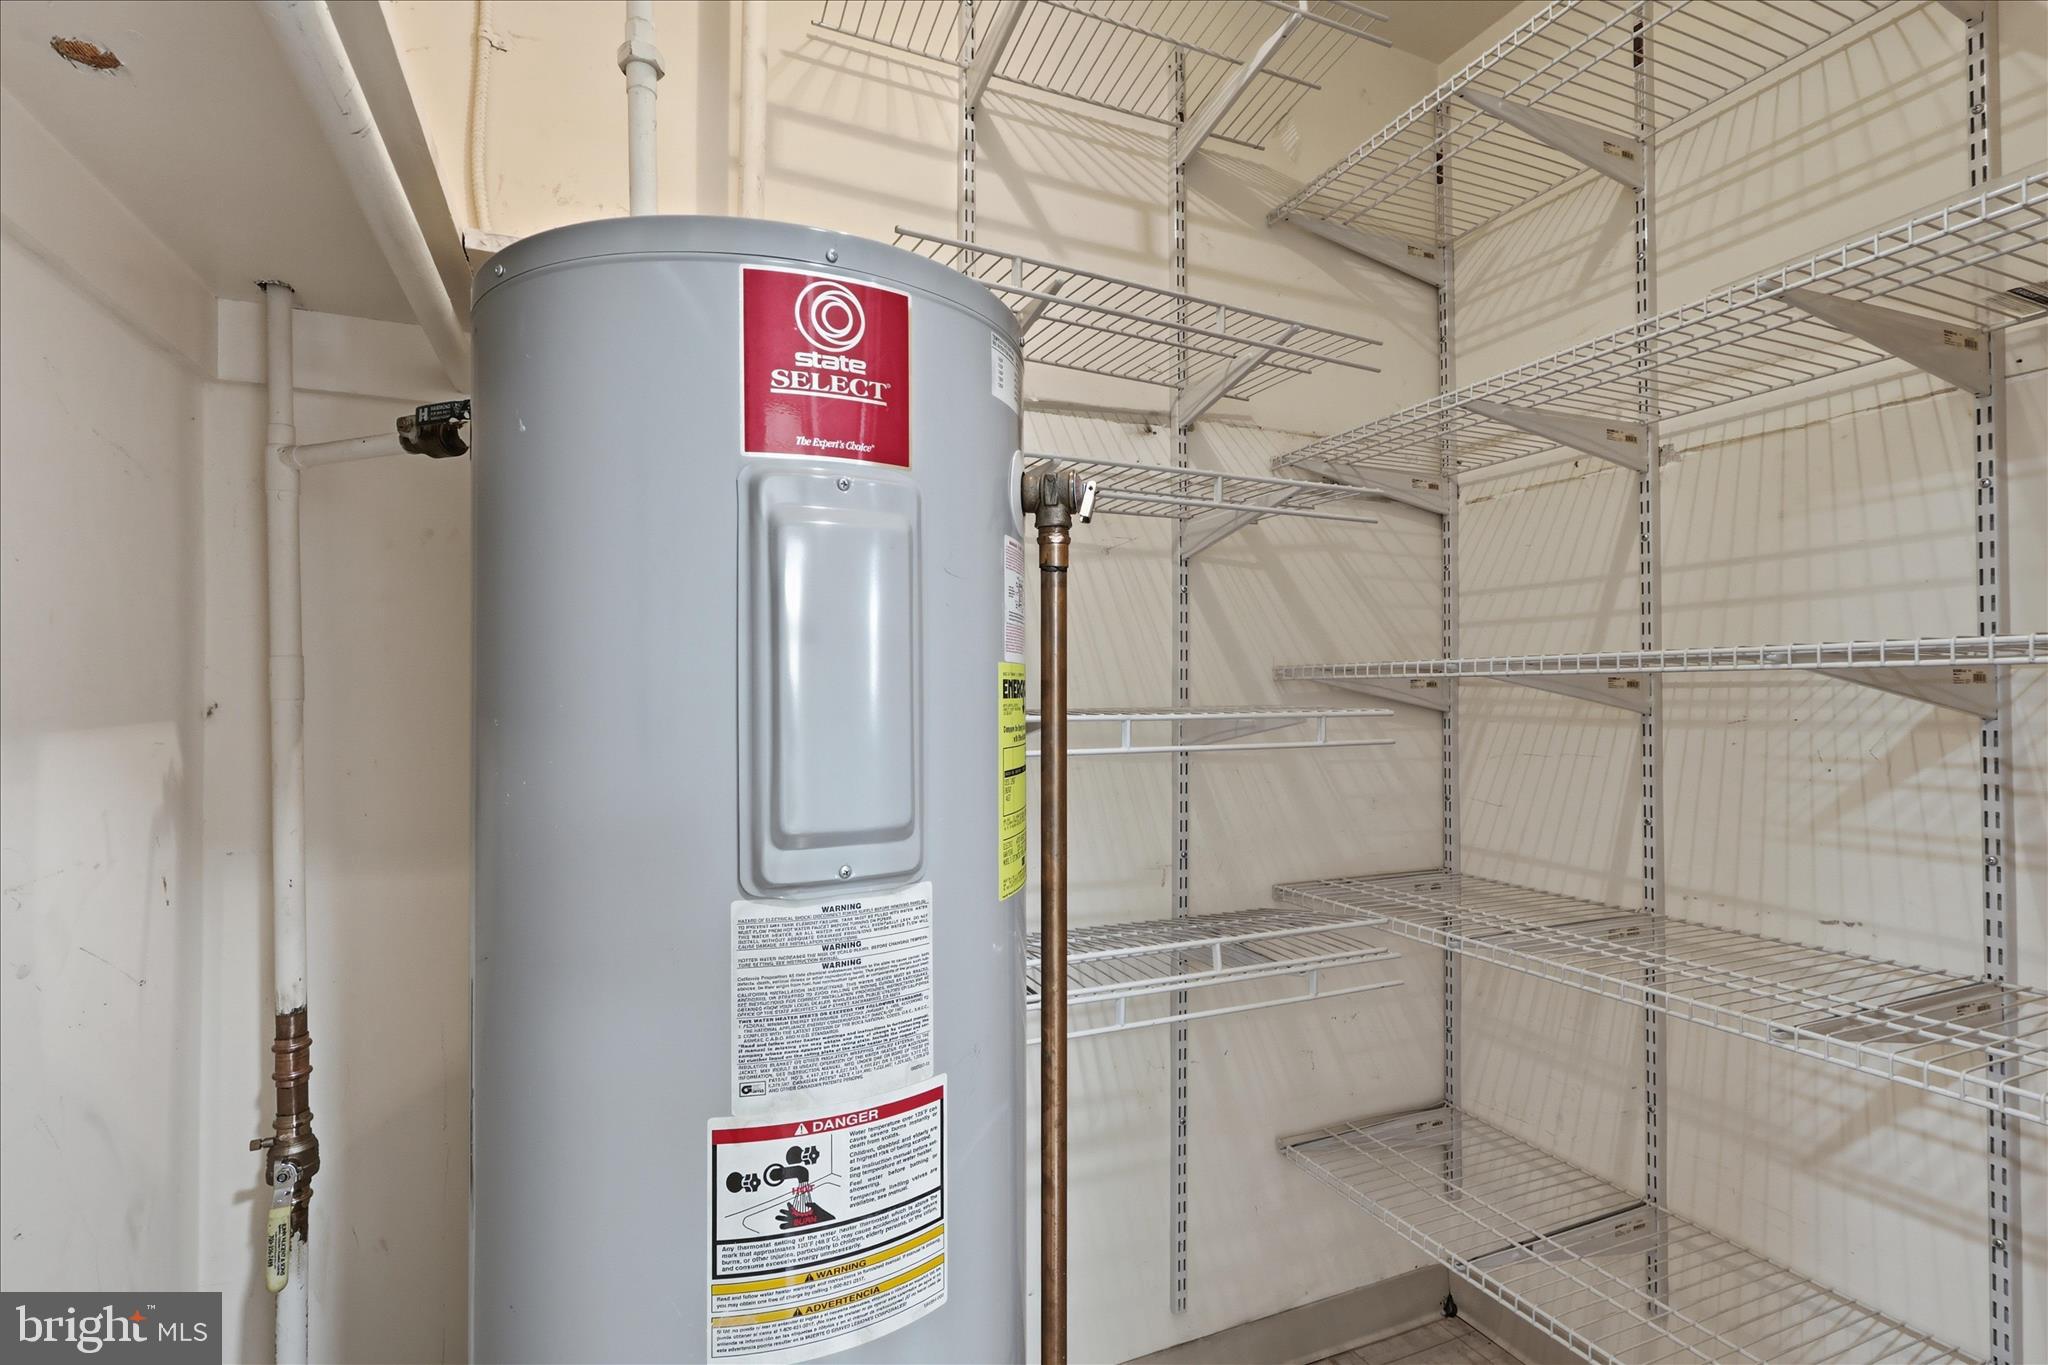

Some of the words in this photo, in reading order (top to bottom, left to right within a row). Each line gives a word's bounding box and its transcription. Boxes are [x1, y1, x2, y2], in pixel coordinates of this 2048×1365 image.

[795, 351, 867, 375] state
[796, 436, 812, 446] The
[822, 903, 862, 913] WARNING
[822, 941, 862, 951] WARNING
[822, 959, 862, 969] WARNING
[812, 1109, 879, 1132] DANGER
[816, 1259, 866, 1280] WARNING
[805, 1286, 880, 1313] ADVERTENCIA
